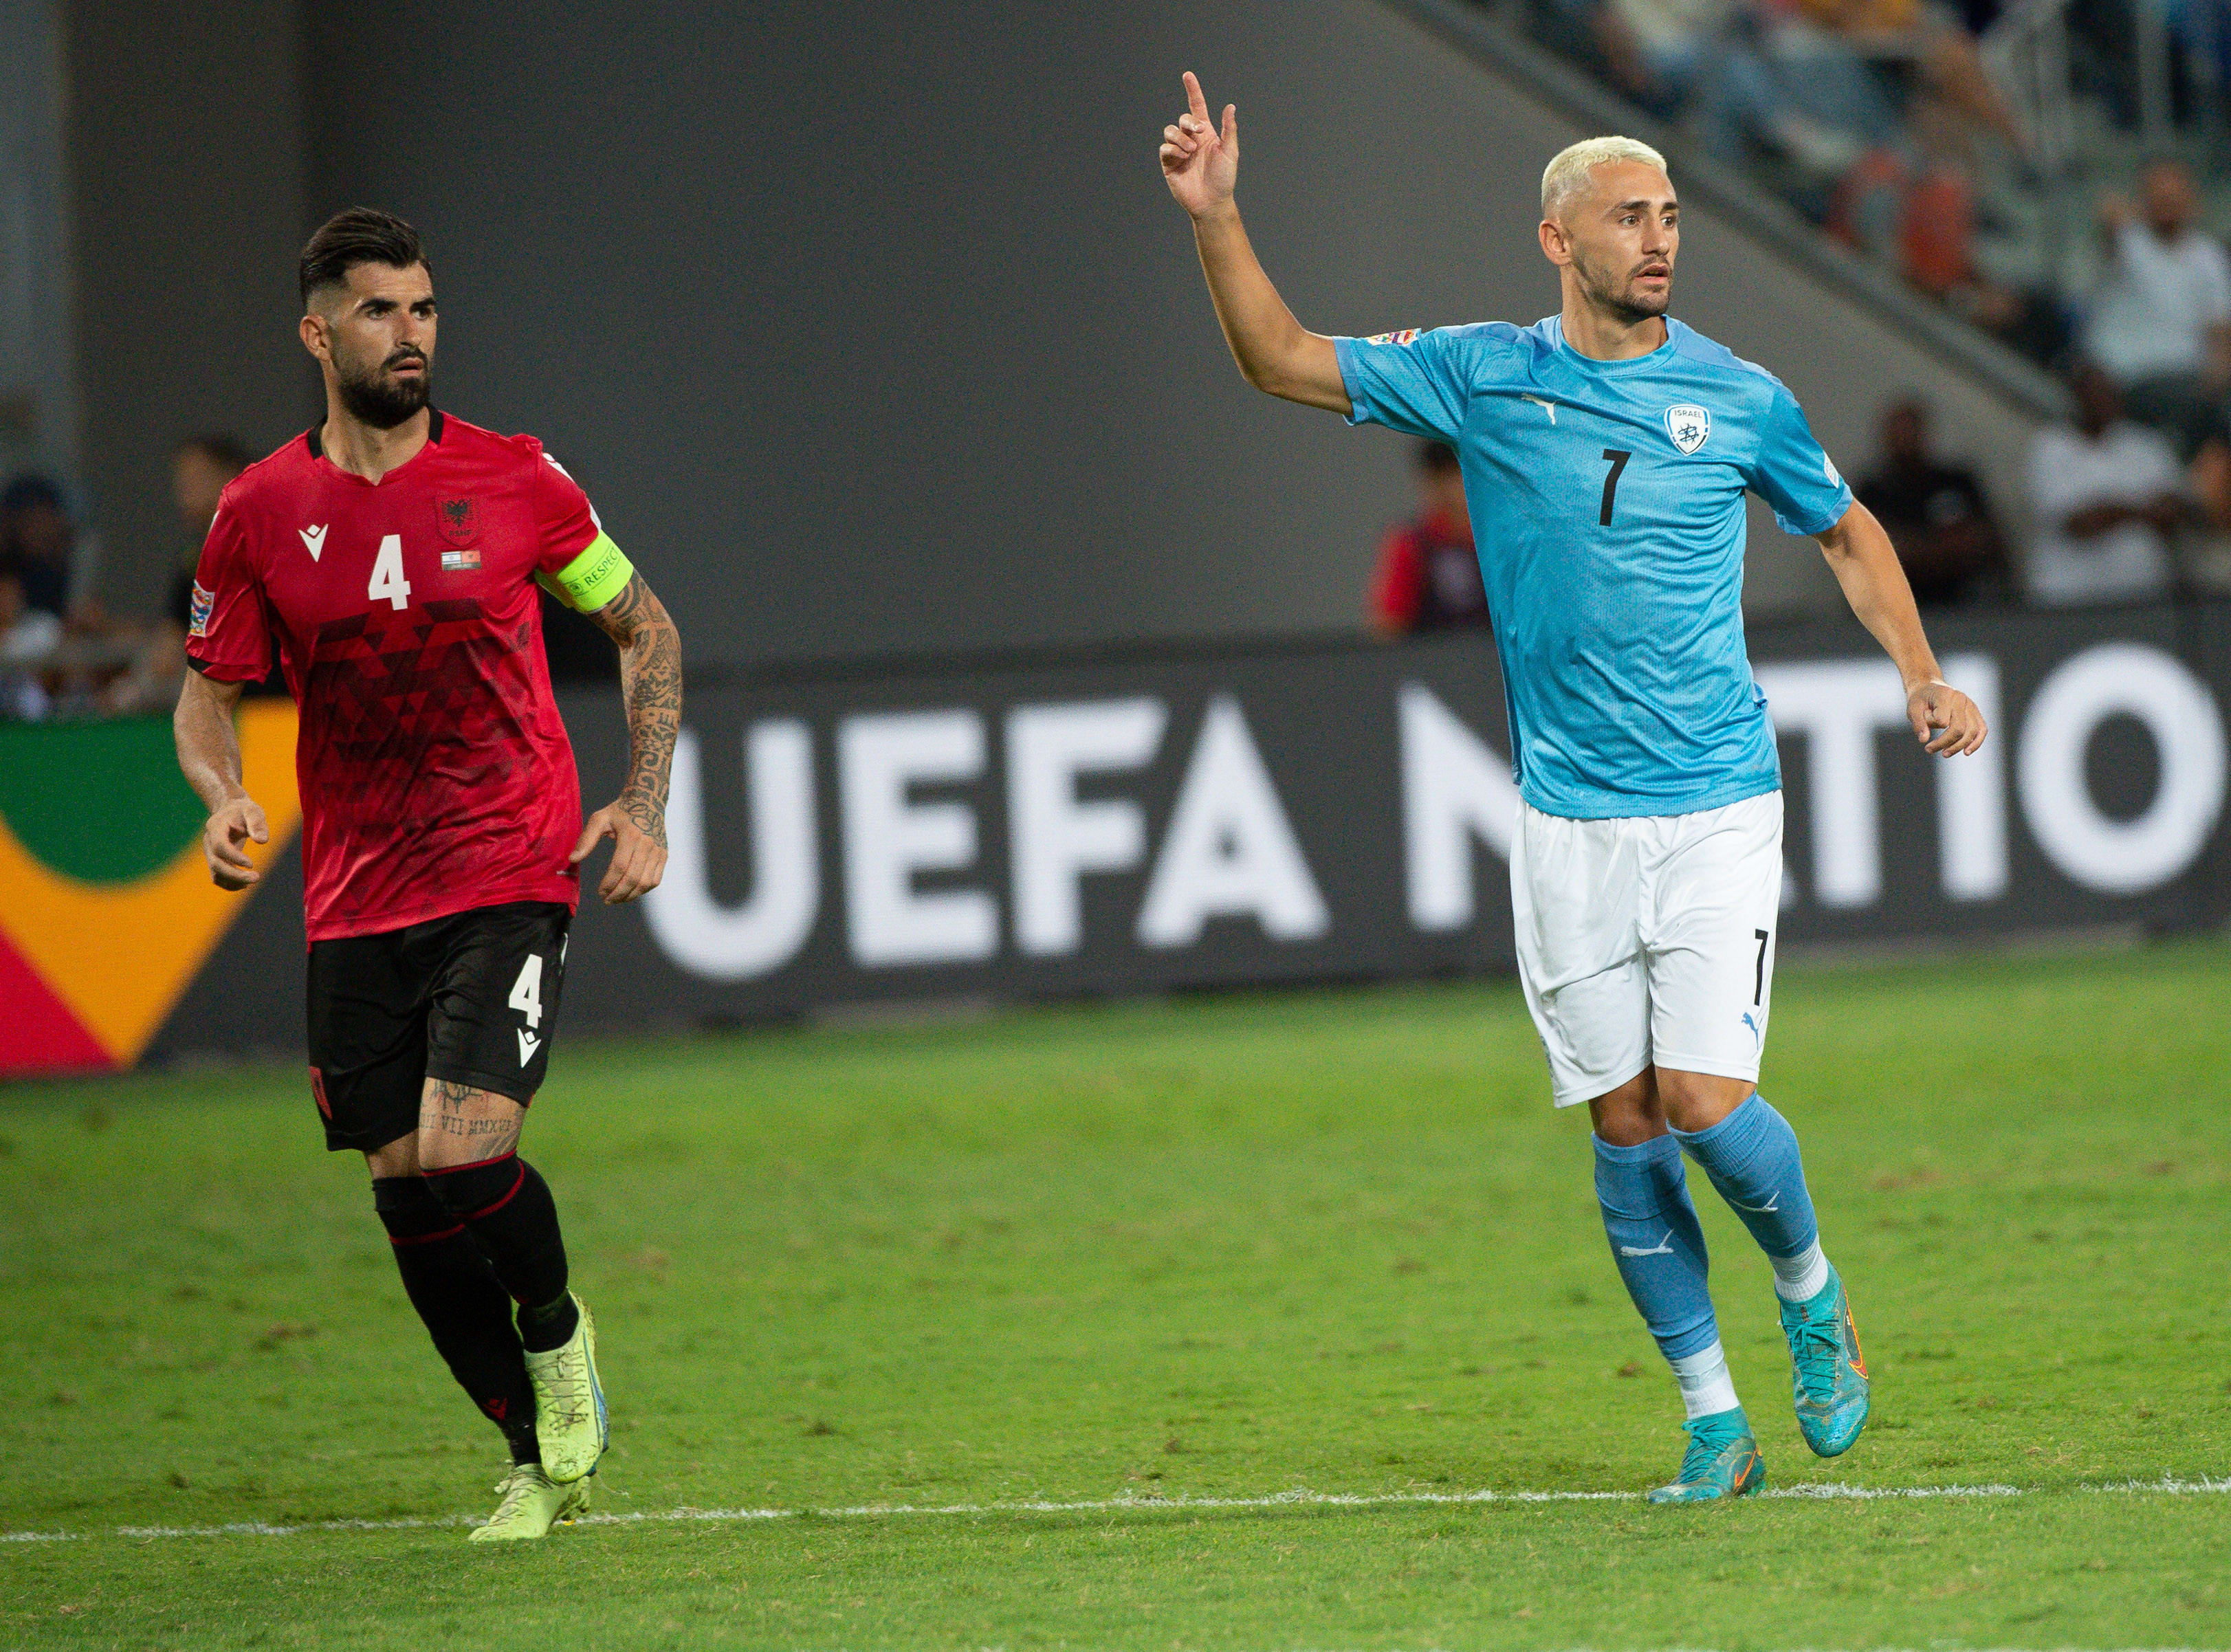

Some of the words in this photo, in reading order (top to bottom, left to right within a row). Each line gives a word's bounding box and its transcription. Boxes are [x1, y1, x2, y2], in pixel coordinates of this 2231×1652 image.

[1674, 410, 1702, 419] ISRAEL
[1599, 448, 1632, 527] 7
[368, 533, 411, 610] 4
[642, 700, 1326, 976] UEFA
[1400, 646, 2225, 929] NTIO
[508, 954, 542, 1029] 4
[1754, 928, 1769, 1006] 7
